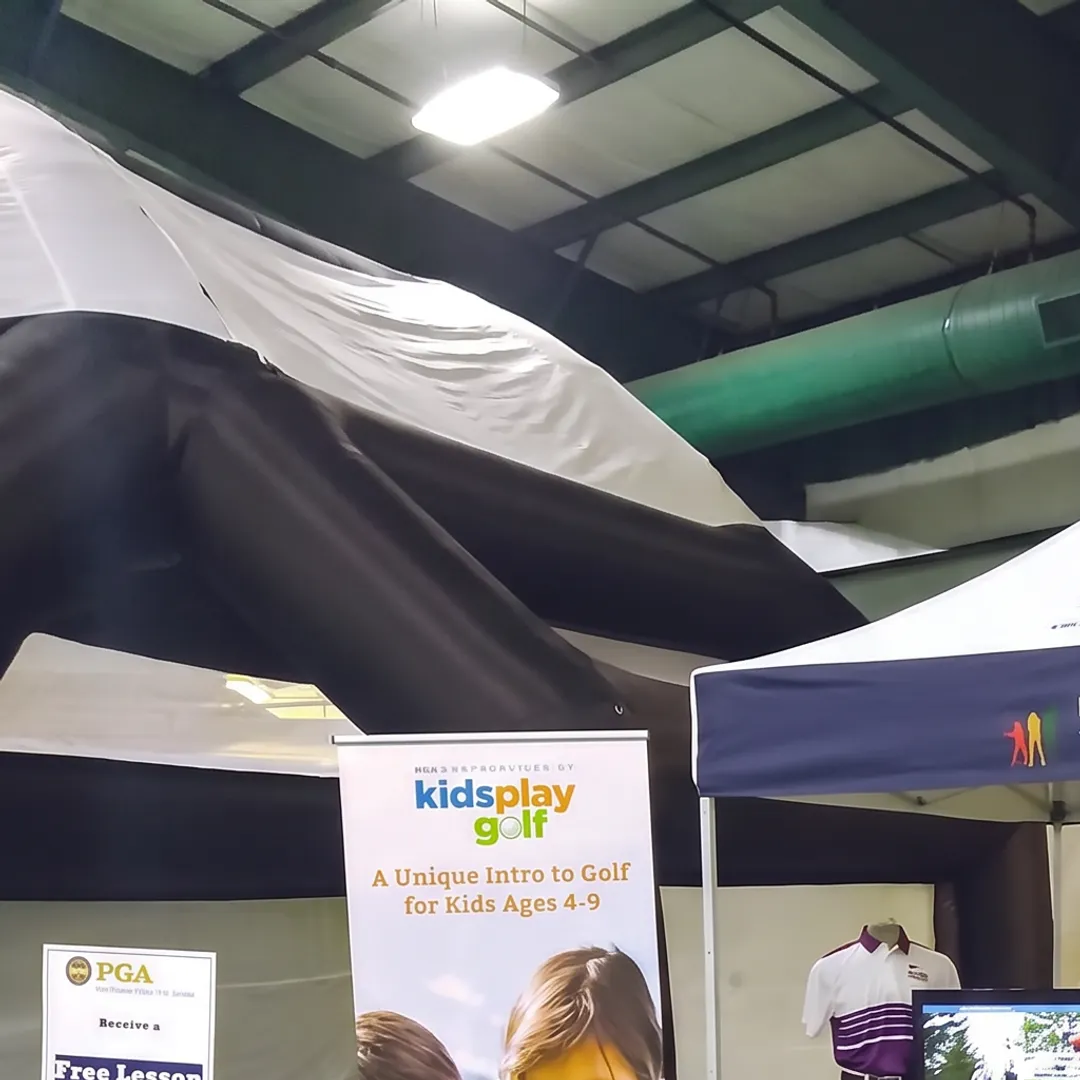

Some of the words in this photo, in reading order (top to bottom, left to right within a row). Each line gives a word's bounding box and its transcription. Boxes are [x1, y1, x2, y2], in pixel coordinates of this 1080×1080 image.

[415, 777, 576, 815] kidsplay
[474, 809, 548, 846] golf
[372, 869, 389, 887] A
[395, 866, 479, 890] Unique
[486, 865, 545, 884] Intro
[551, 864, 574, 883] to
[581, 862, 631, 882] Golf
[404, 896, 439, 915] for
[445, 894, 496, 914] Kids
[502, 893, 557, 918] Ages
[563, 892, 601, 911] 4-9
[96, 962, 153, 984] PGA
[99, 1018, 149, 1031] Receive
[153, 1023, 160, 1031] a
